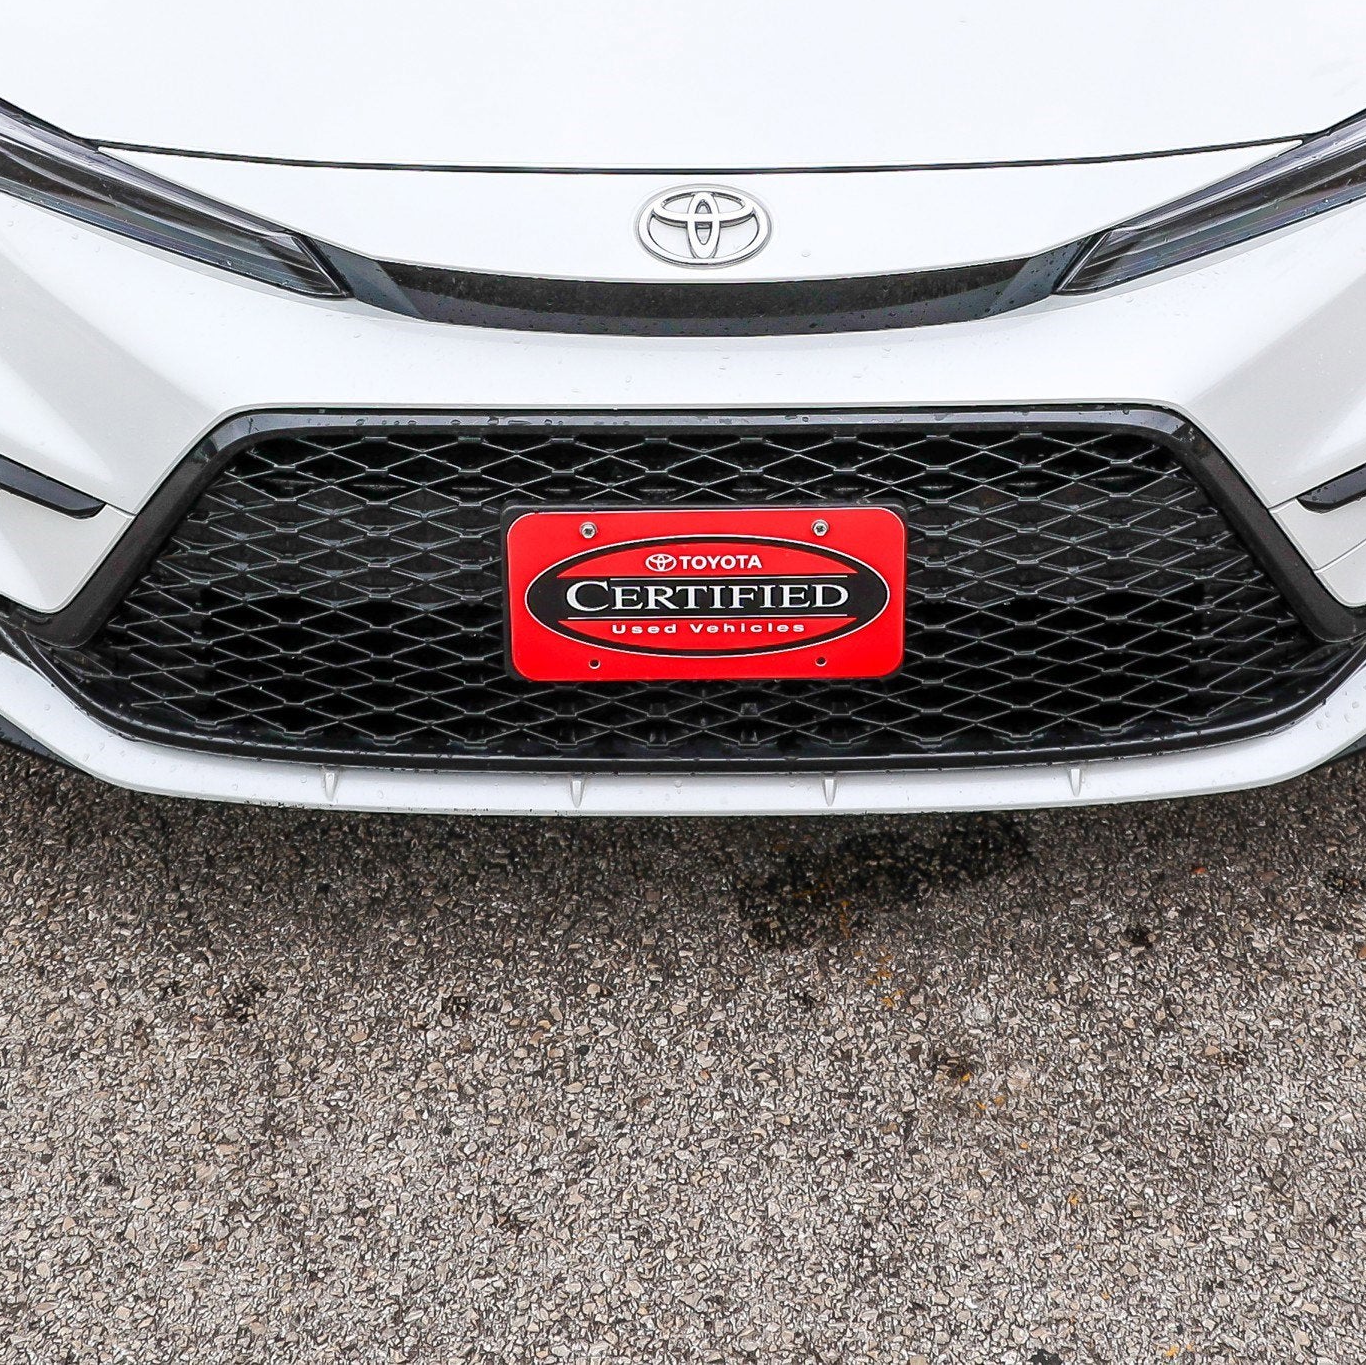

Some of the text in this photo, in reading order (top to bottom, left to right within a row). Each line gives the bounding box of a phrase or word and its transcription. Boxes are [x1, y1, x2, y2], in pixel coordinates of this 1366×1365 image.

[679, 554, 763, 570] TOYOTA
[565, 580, 849, 613] CERTIFIED
[611, 622, 805, 635] Used Vehicles
